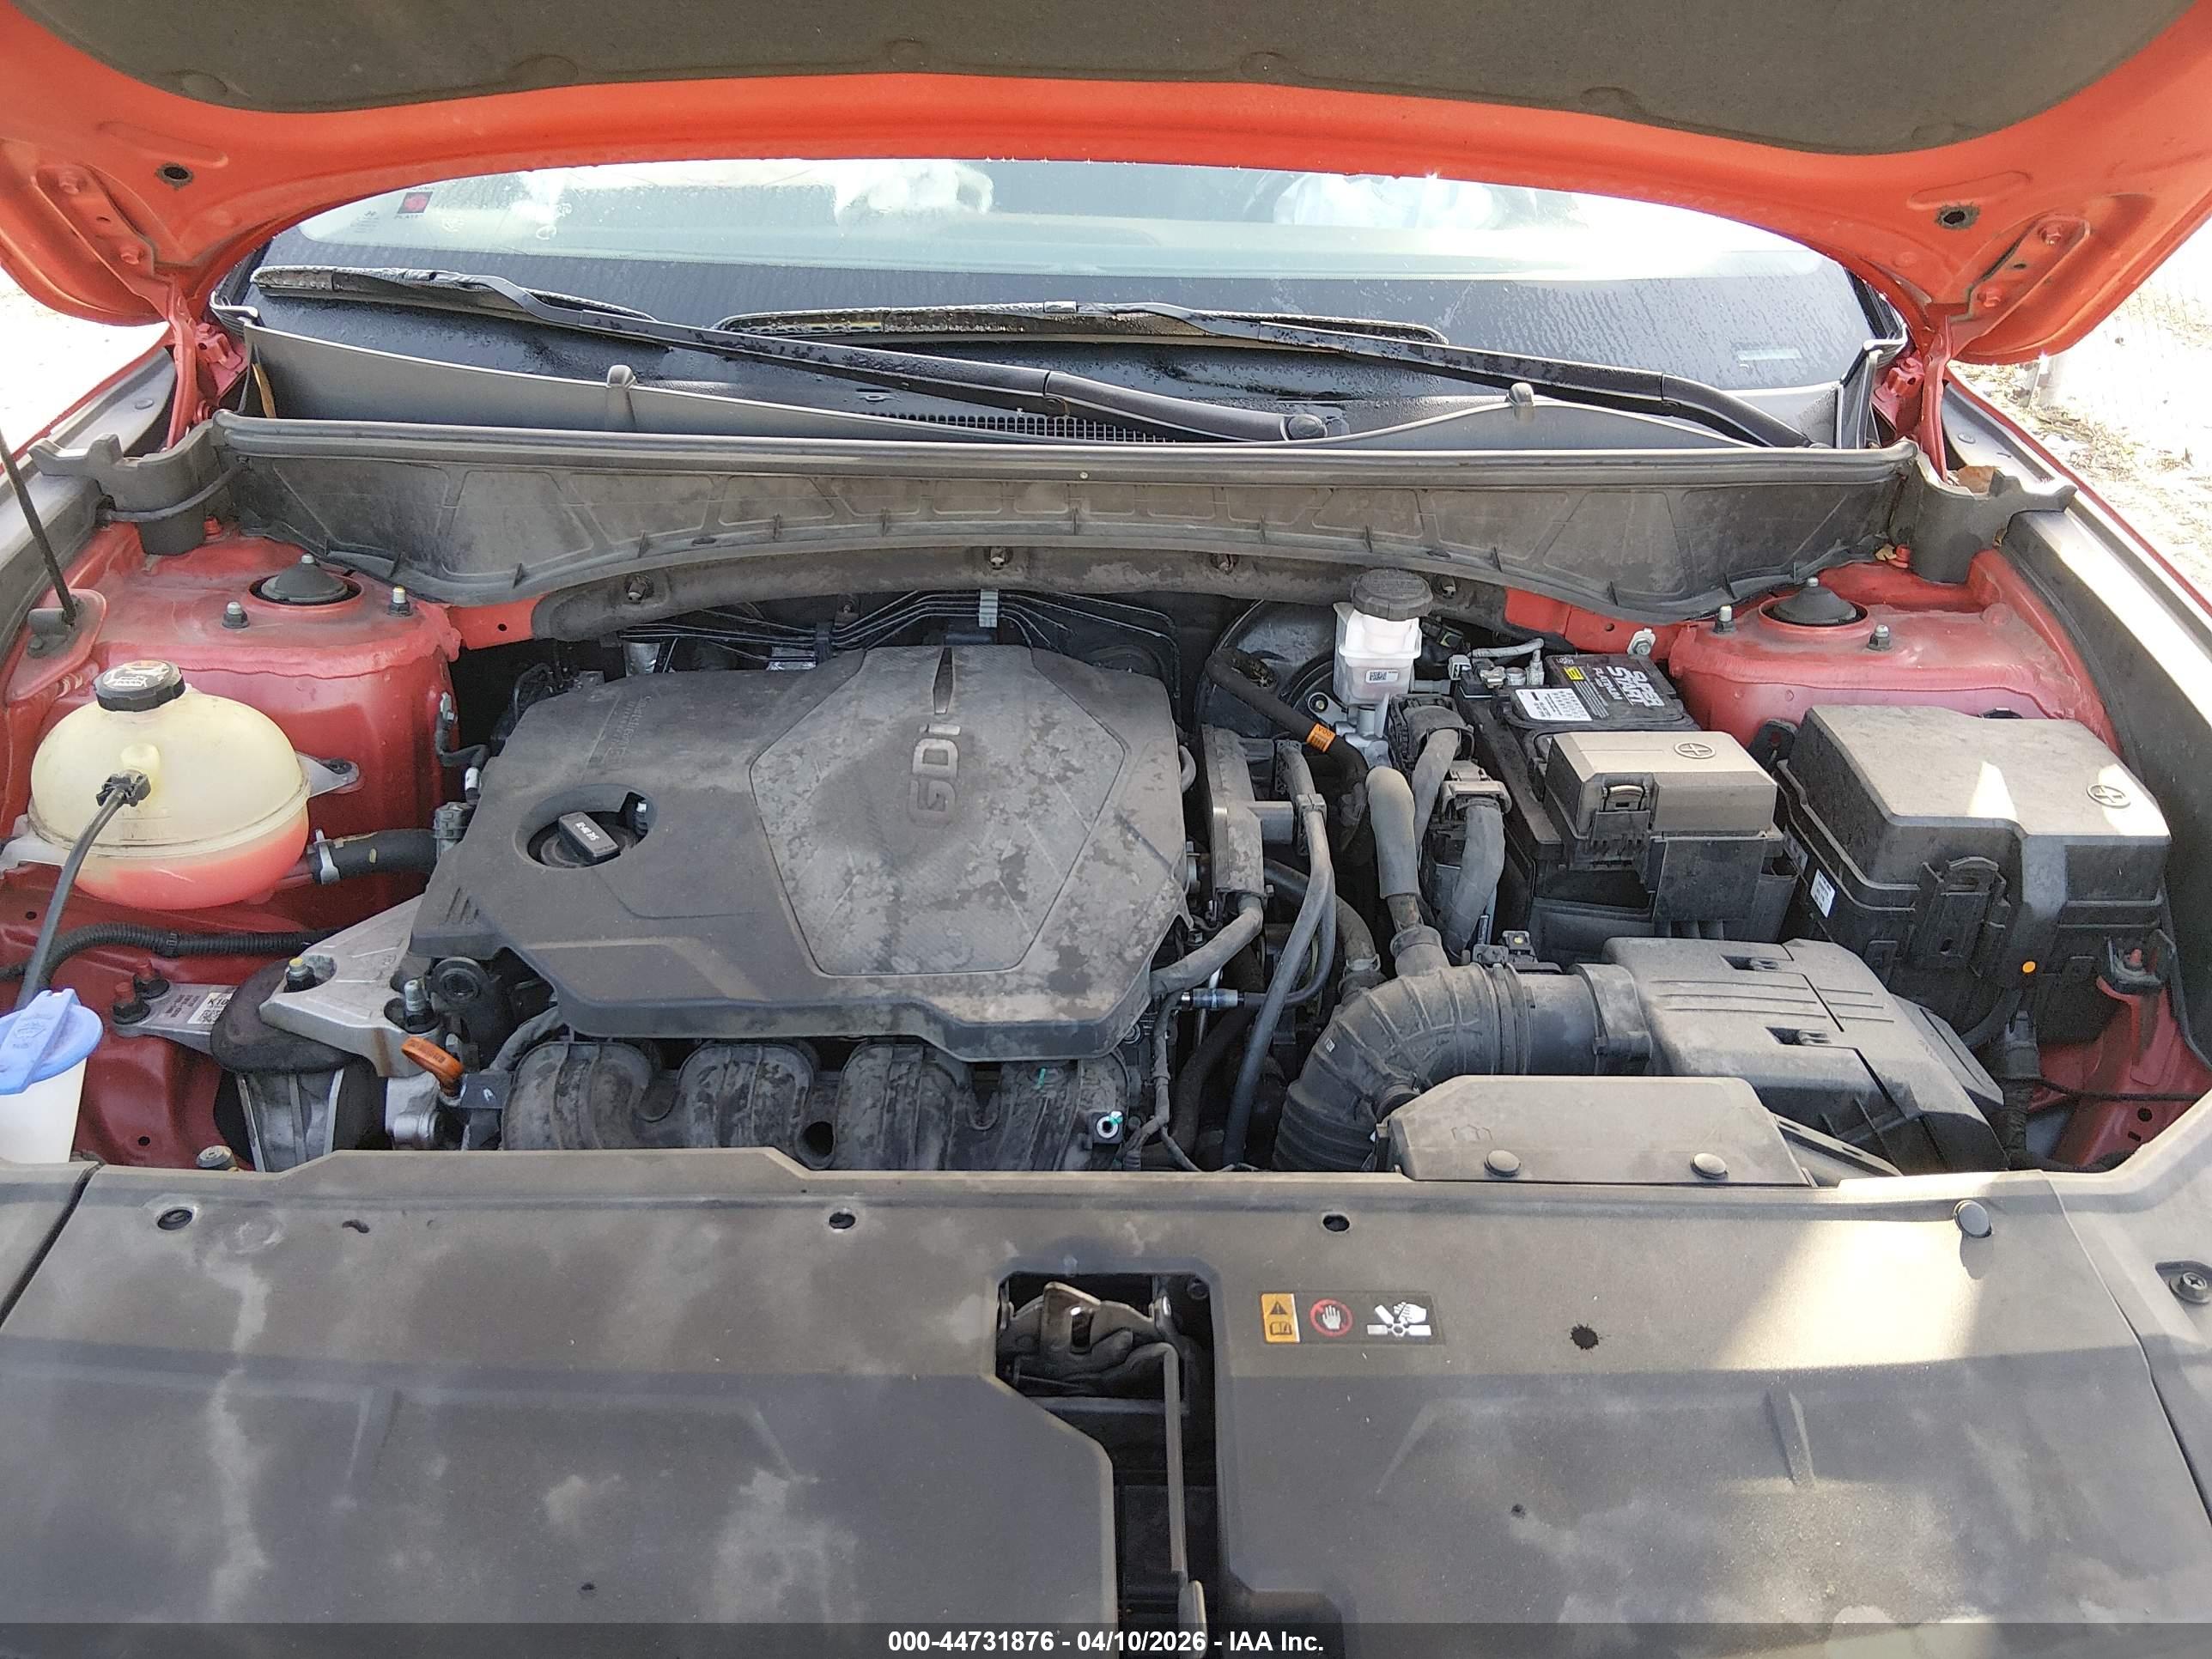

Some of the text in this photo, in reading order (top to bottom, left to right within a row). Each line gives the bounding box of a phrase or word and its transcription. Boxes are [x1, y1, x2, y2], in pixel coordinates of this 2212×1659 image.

[1592, 667, 1623, 700] PLATINUM
[1606, 665, 1650, 707] START
[1629, 670, 1665, 707] SUPER
